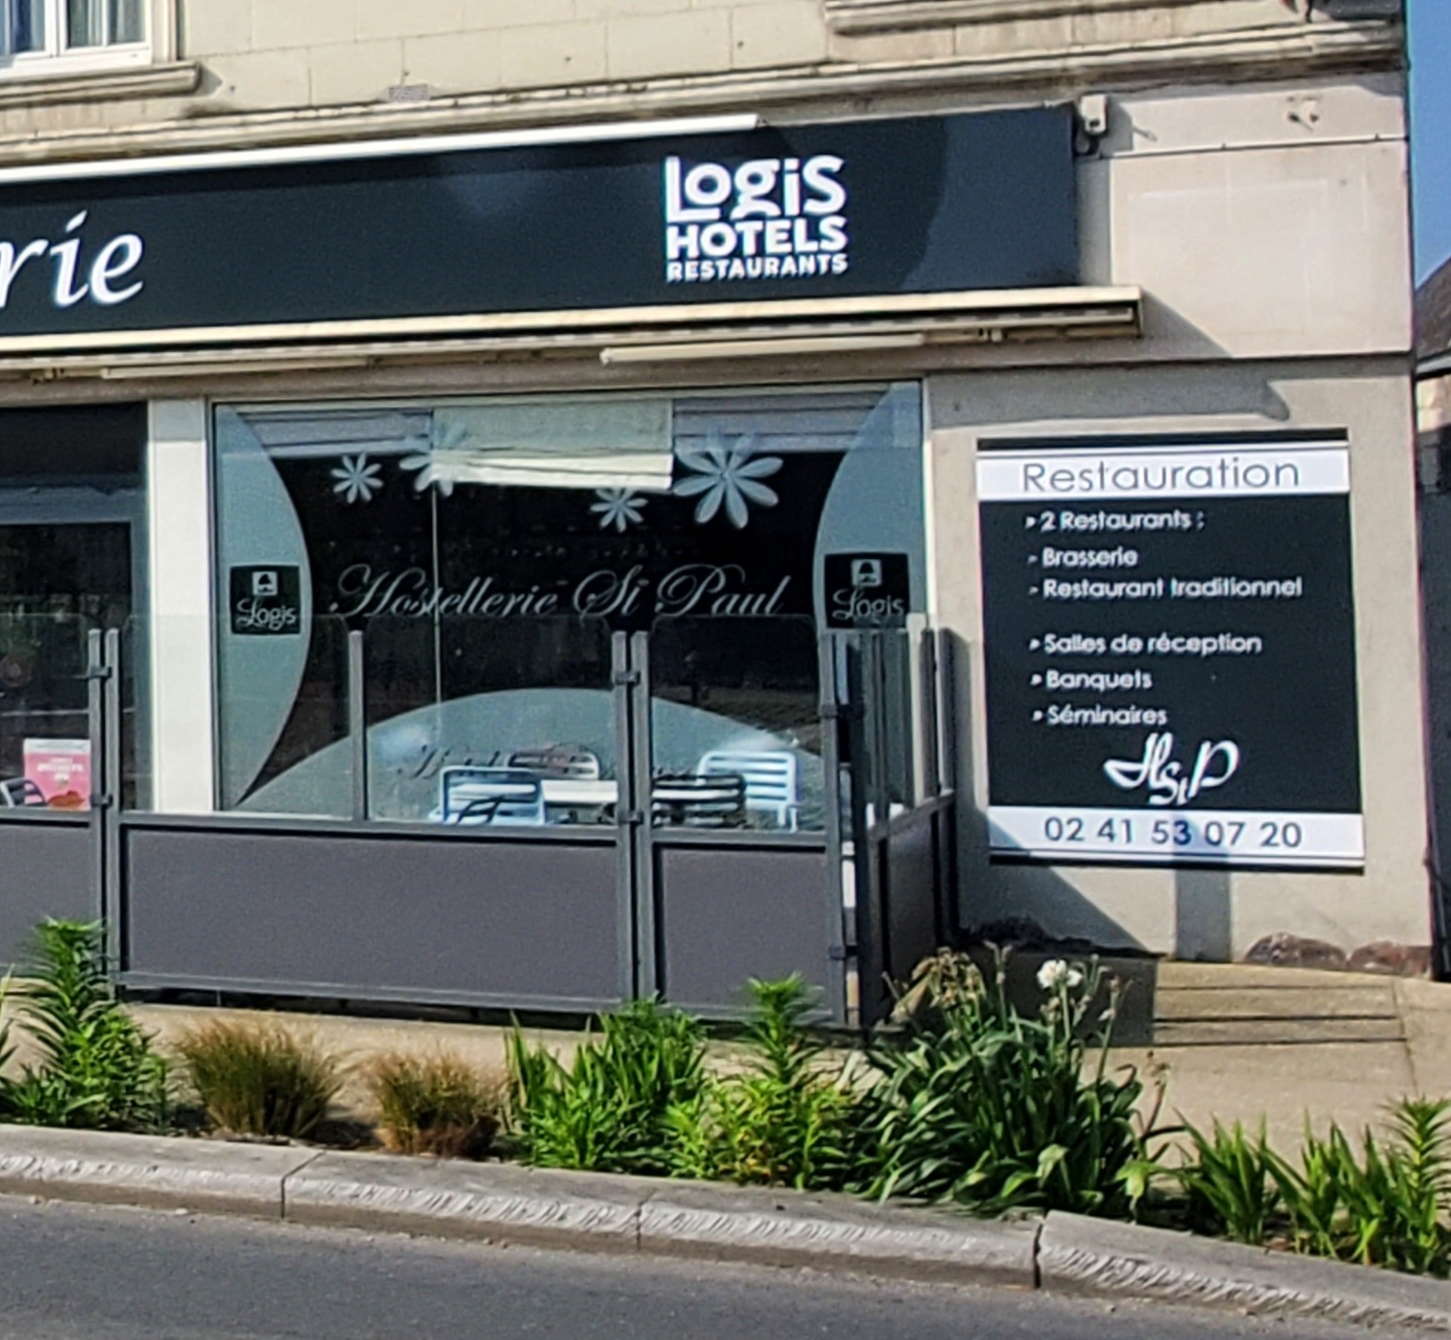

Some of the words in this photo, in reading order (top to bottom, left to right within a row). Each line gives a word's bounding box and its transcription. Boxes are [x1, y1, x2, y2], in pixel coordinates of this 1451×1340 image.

[665, 215, 849, 260] HOTELS
[666, 253, 849, 283] RESTAURANTS
[1022, 457, 1300, 492] Restauration
[1040, 511, 1056, 532] 2
[1060, 510, 1192, 532] Restaurants
[1042, 546, 1139, 567] Brasserie
[329, 564, 558, 618] Hostellerie
[573, 564, 644, 620] St
[654, 563, 792, 617] Paul
[1043, 578, 1163, 600] Restaurant
[1171, 575, 1302, 598] traditionnel
[236, 598, 297, 630] Logis
[1044, 633, 1106, 653] Salles
[1110, 633, 1143, 653] de
[1149, 632, 1263, 655] réception
[1046, 669, 1153, 692] Banquets
[1048, 704, 1168, 726] Séminaires
[1044, 817, 1084, 842] 02
[1098, 818, 1133, 843] 41
[1151, 820, 1192, 846] 53
[1204, 820, 1247, 847] 07
[1260, 822, 1303, 848] 20
